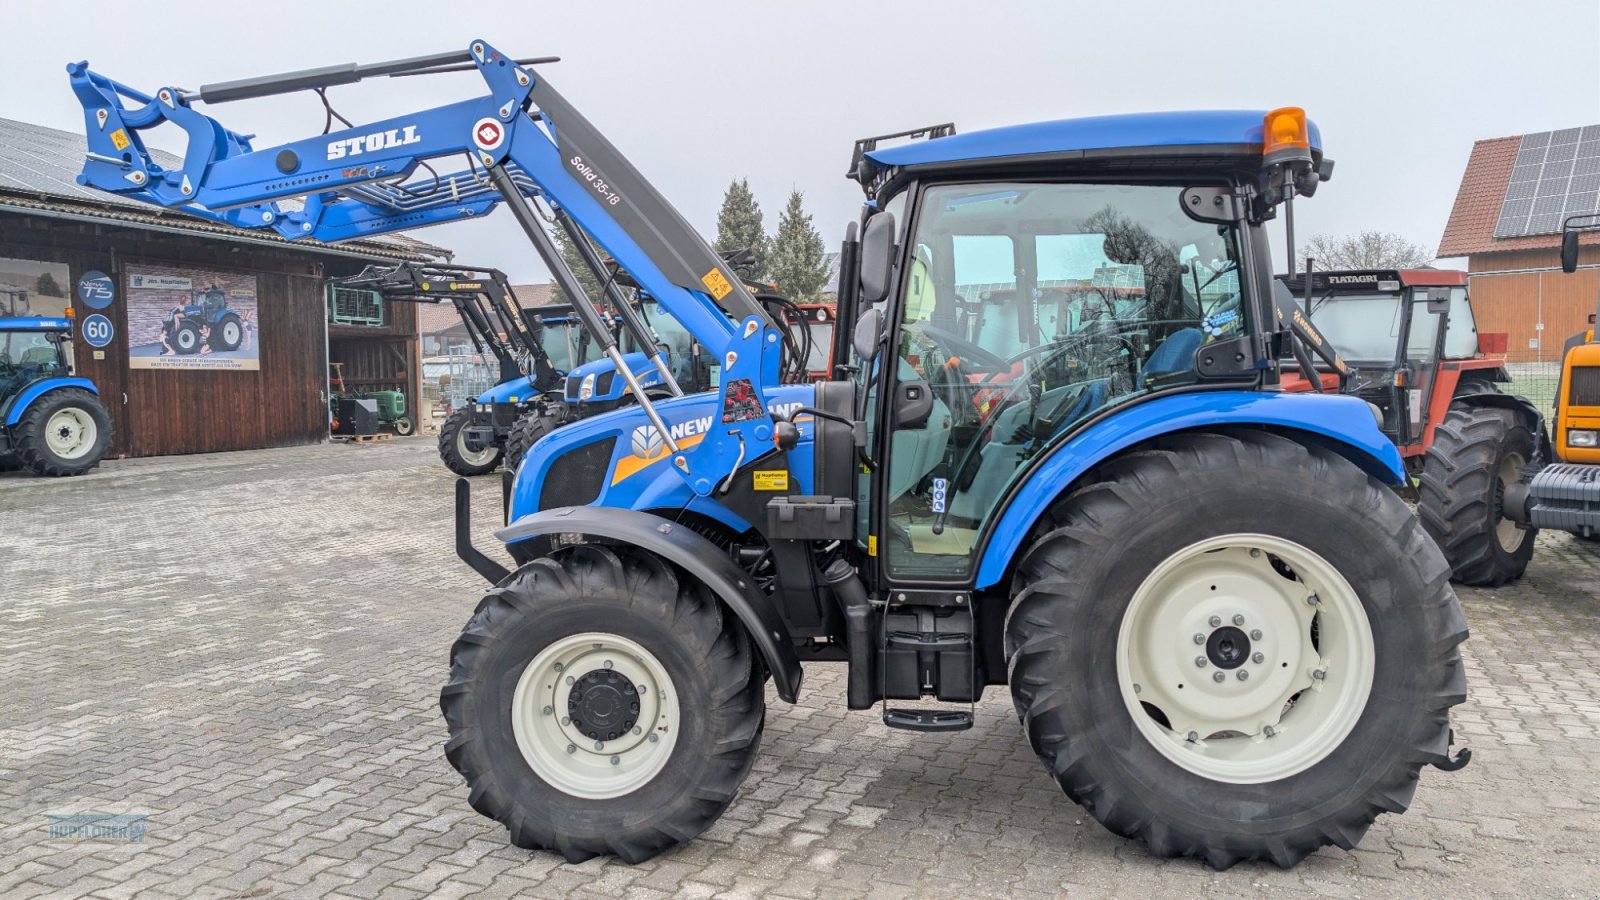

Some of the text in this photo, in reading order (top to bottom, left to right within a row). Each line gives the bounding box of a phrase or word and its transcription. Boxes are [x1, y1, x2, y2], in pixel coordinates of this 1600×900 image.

[327, 125, 421, 161] STOLL
[570, 156, 620, 206] Solid 35-18
[1328, 275, 1378, 285] FIATAGRI
[87, 321, 109, 339] 60
[670, 416, 713, 440] NEW
